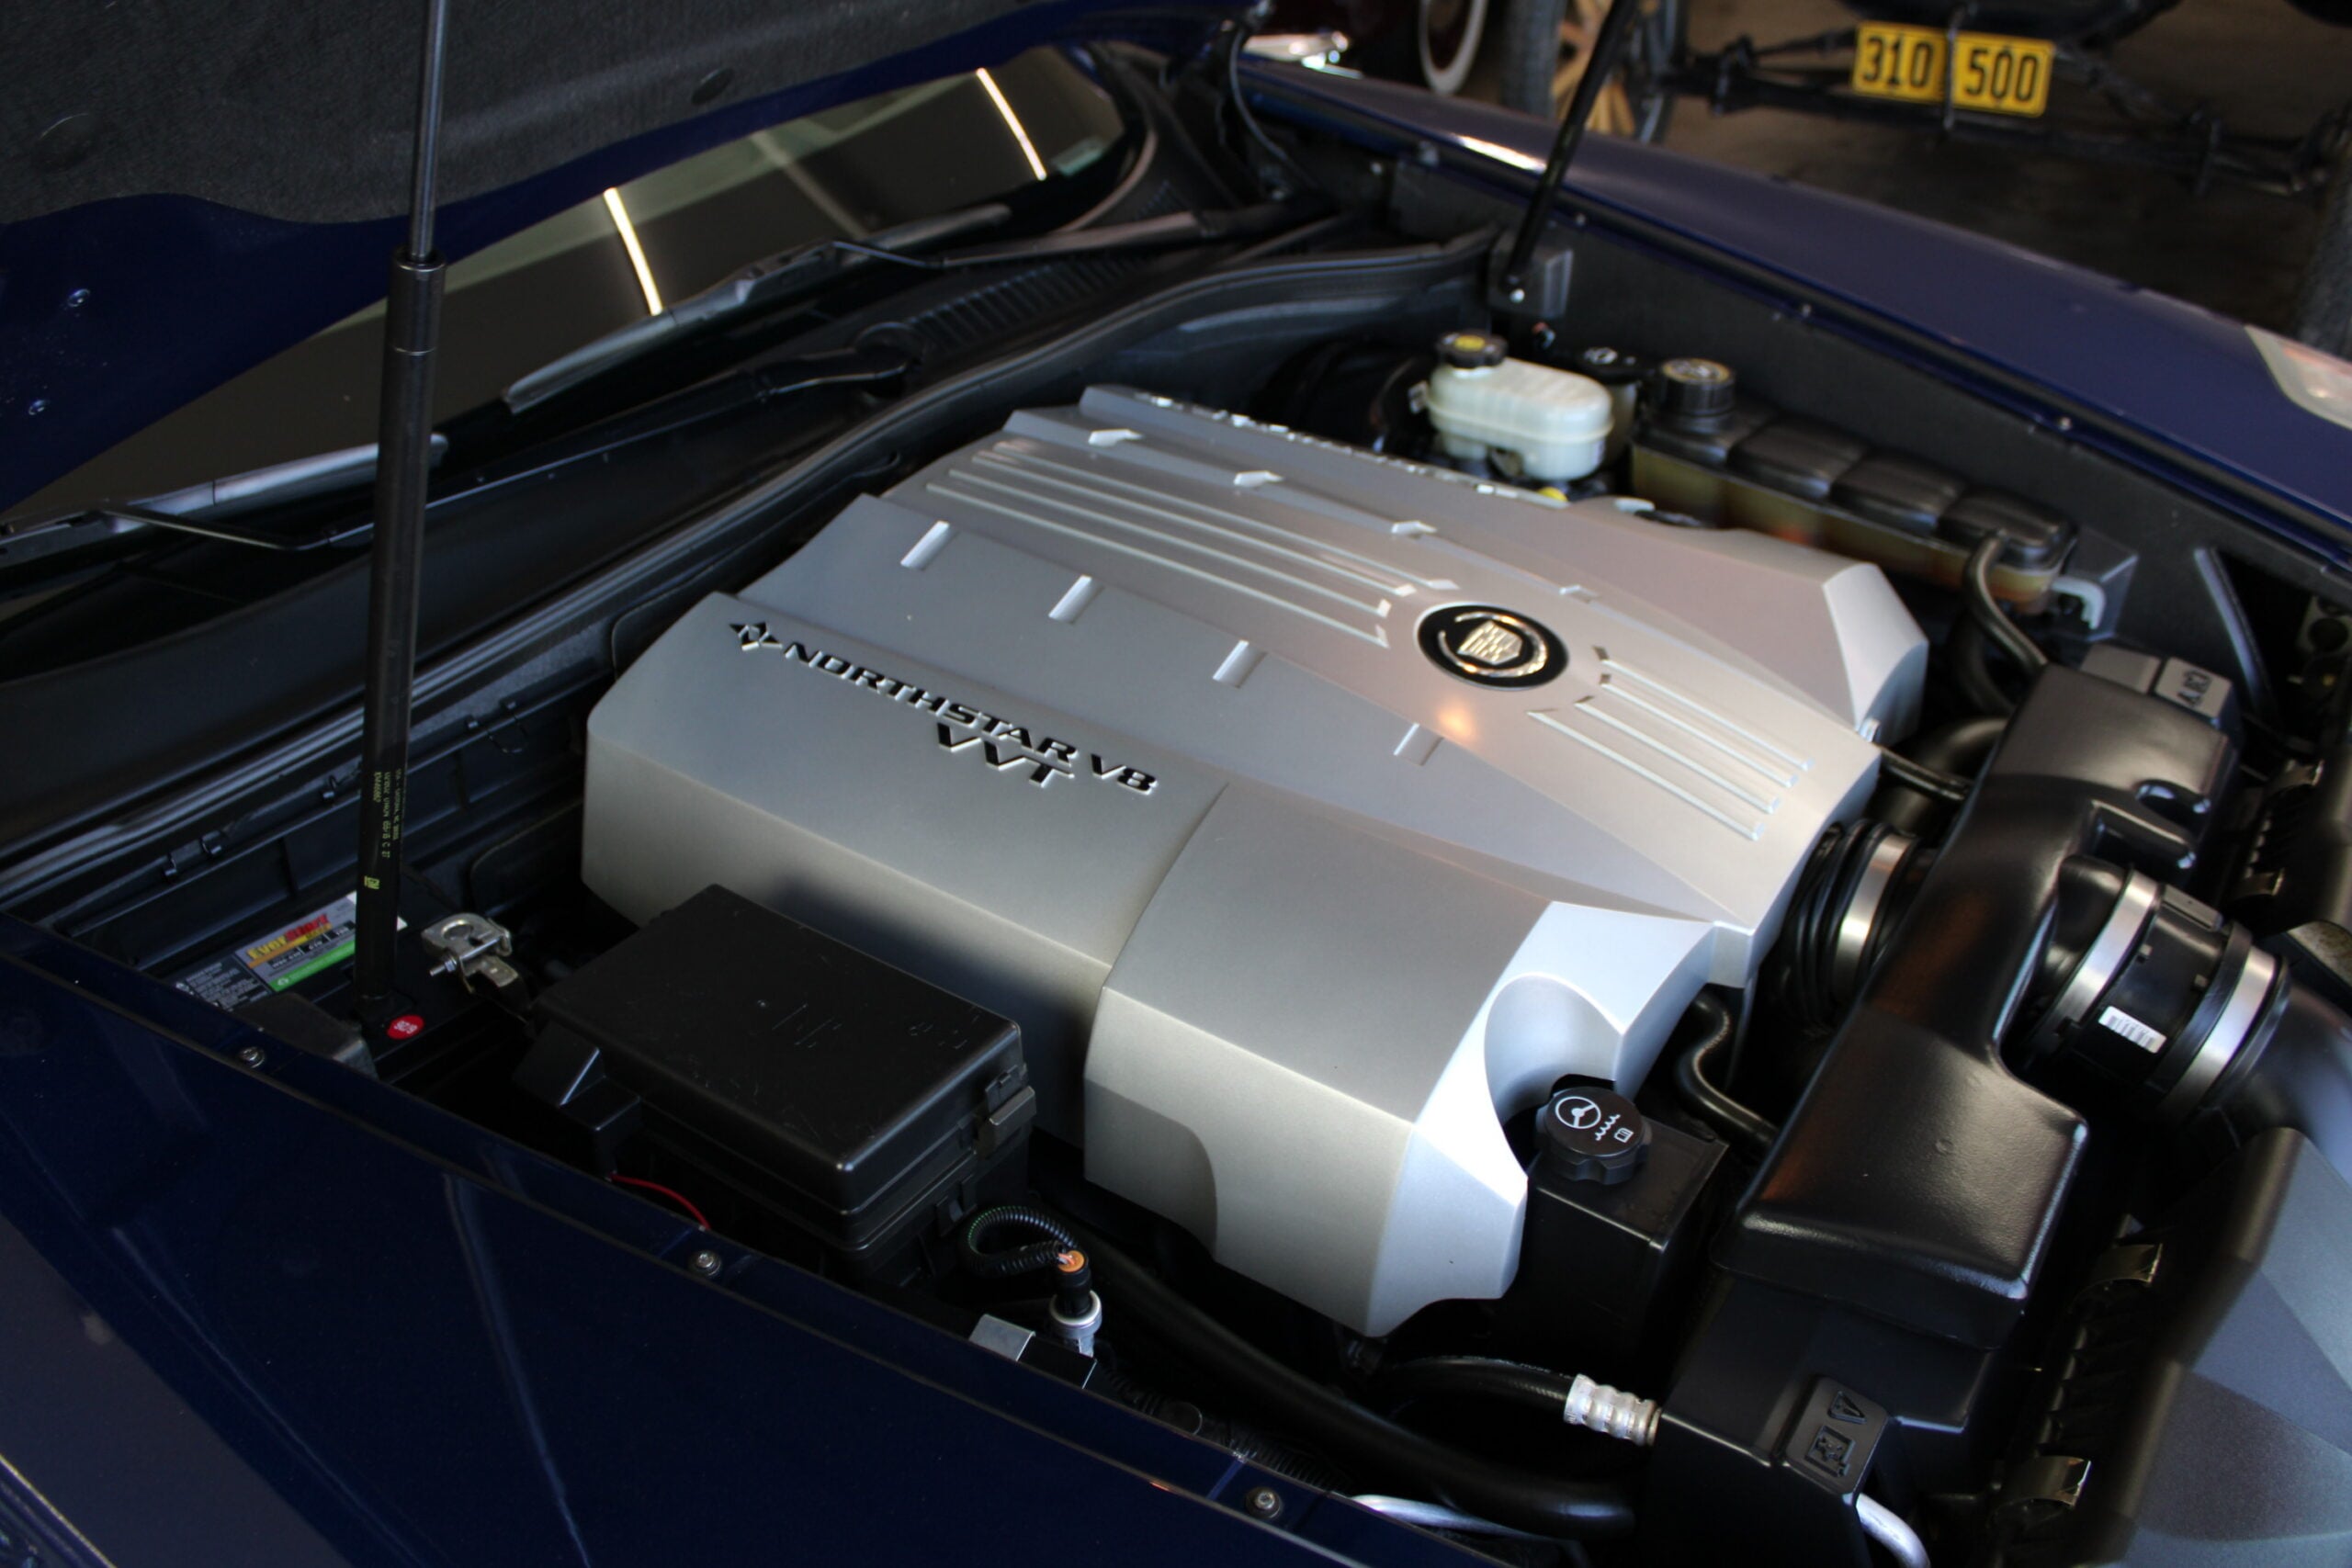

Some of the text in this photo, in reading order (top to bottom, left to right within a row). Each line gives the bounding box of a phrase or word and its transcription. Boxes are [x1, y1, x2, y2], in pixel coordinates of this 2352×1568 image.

[1861, 33, 2040, 102] 310 500
[784, 641, 1159, 795] NORTHSTAR V8
[935, 722, 1076, 788] VVT
